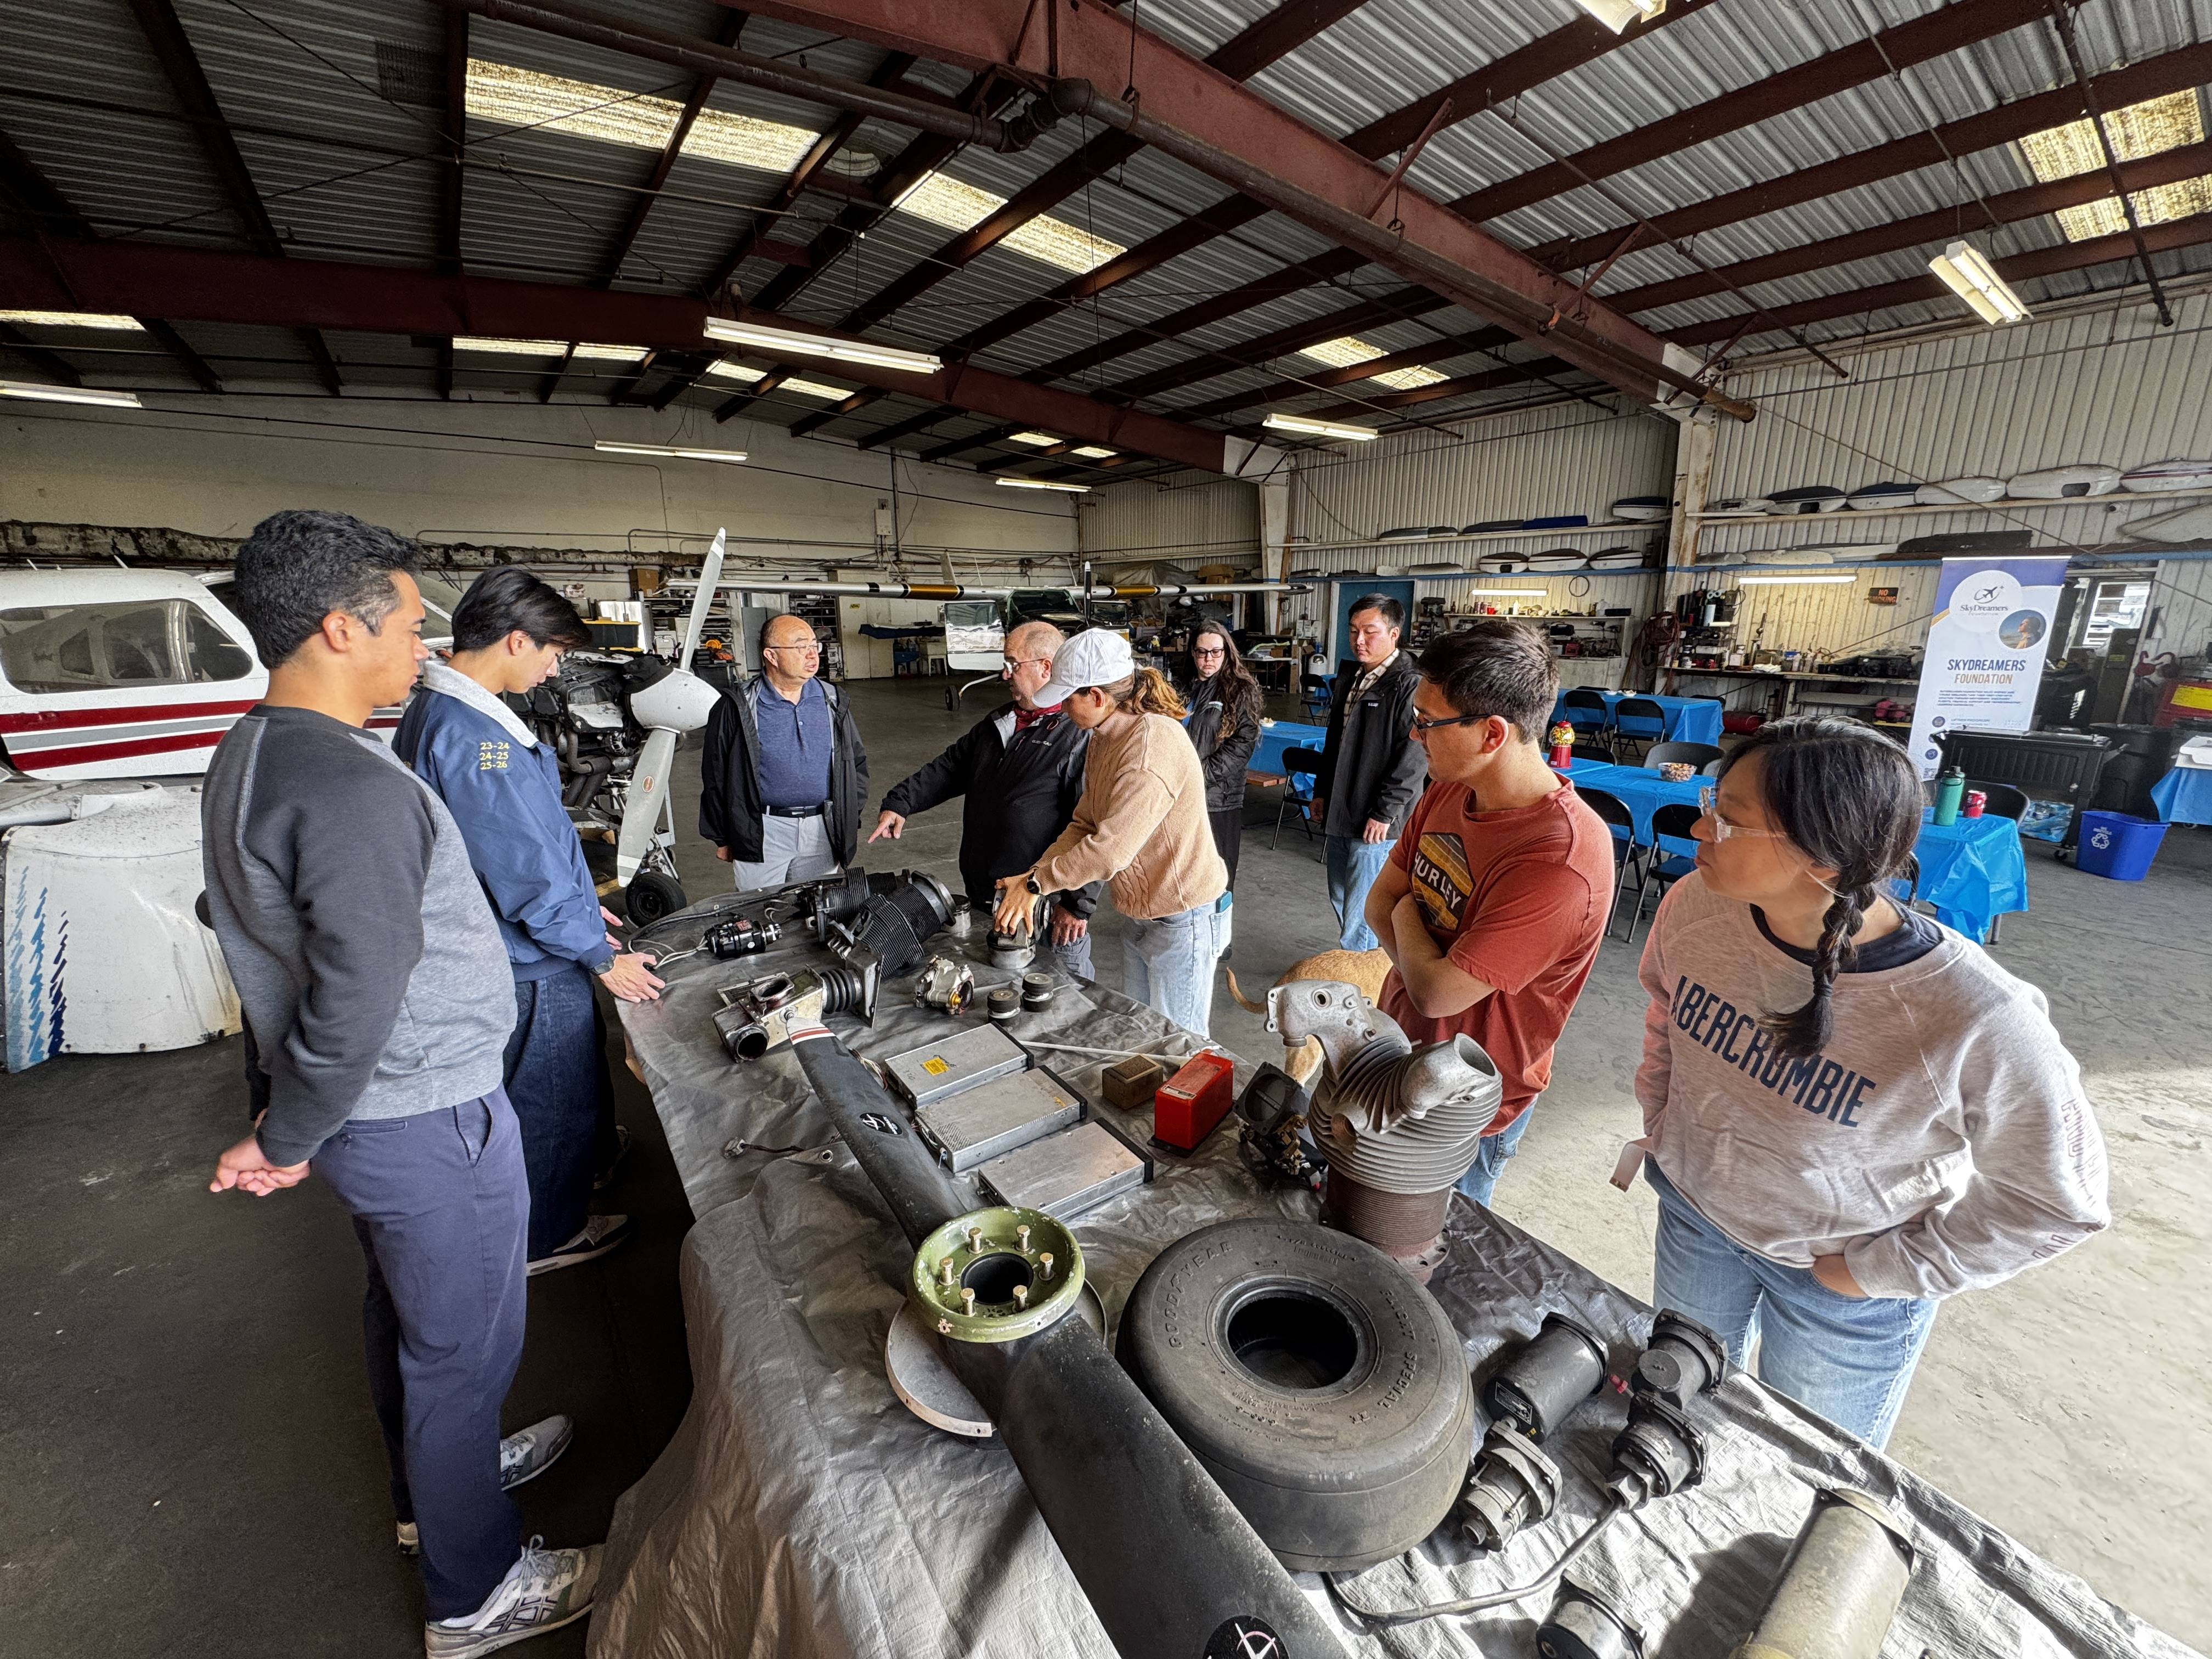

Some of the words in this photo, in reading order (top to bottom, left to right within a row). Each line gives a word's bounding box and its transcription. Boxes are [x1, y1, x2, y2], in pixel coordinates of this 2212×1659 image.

[1960, 605, 2008, 613] SkyDreamers
[1947, 659, 2026, 672] SKYDREAMERS
[1954, 674, 2013, 684] FOUNDATION
[479, 752, 509, 760] 24-25
[480, 761, 508, 770] 25-26
[1414, 851, 1462, 909] HURLEY
[1671, 974, 1877, 1127] ABERCROMBIE
[1165, 1241, 1234, 1349] GOODYEAR
[1377, 1351, 1418, 1409] SPECIAL
